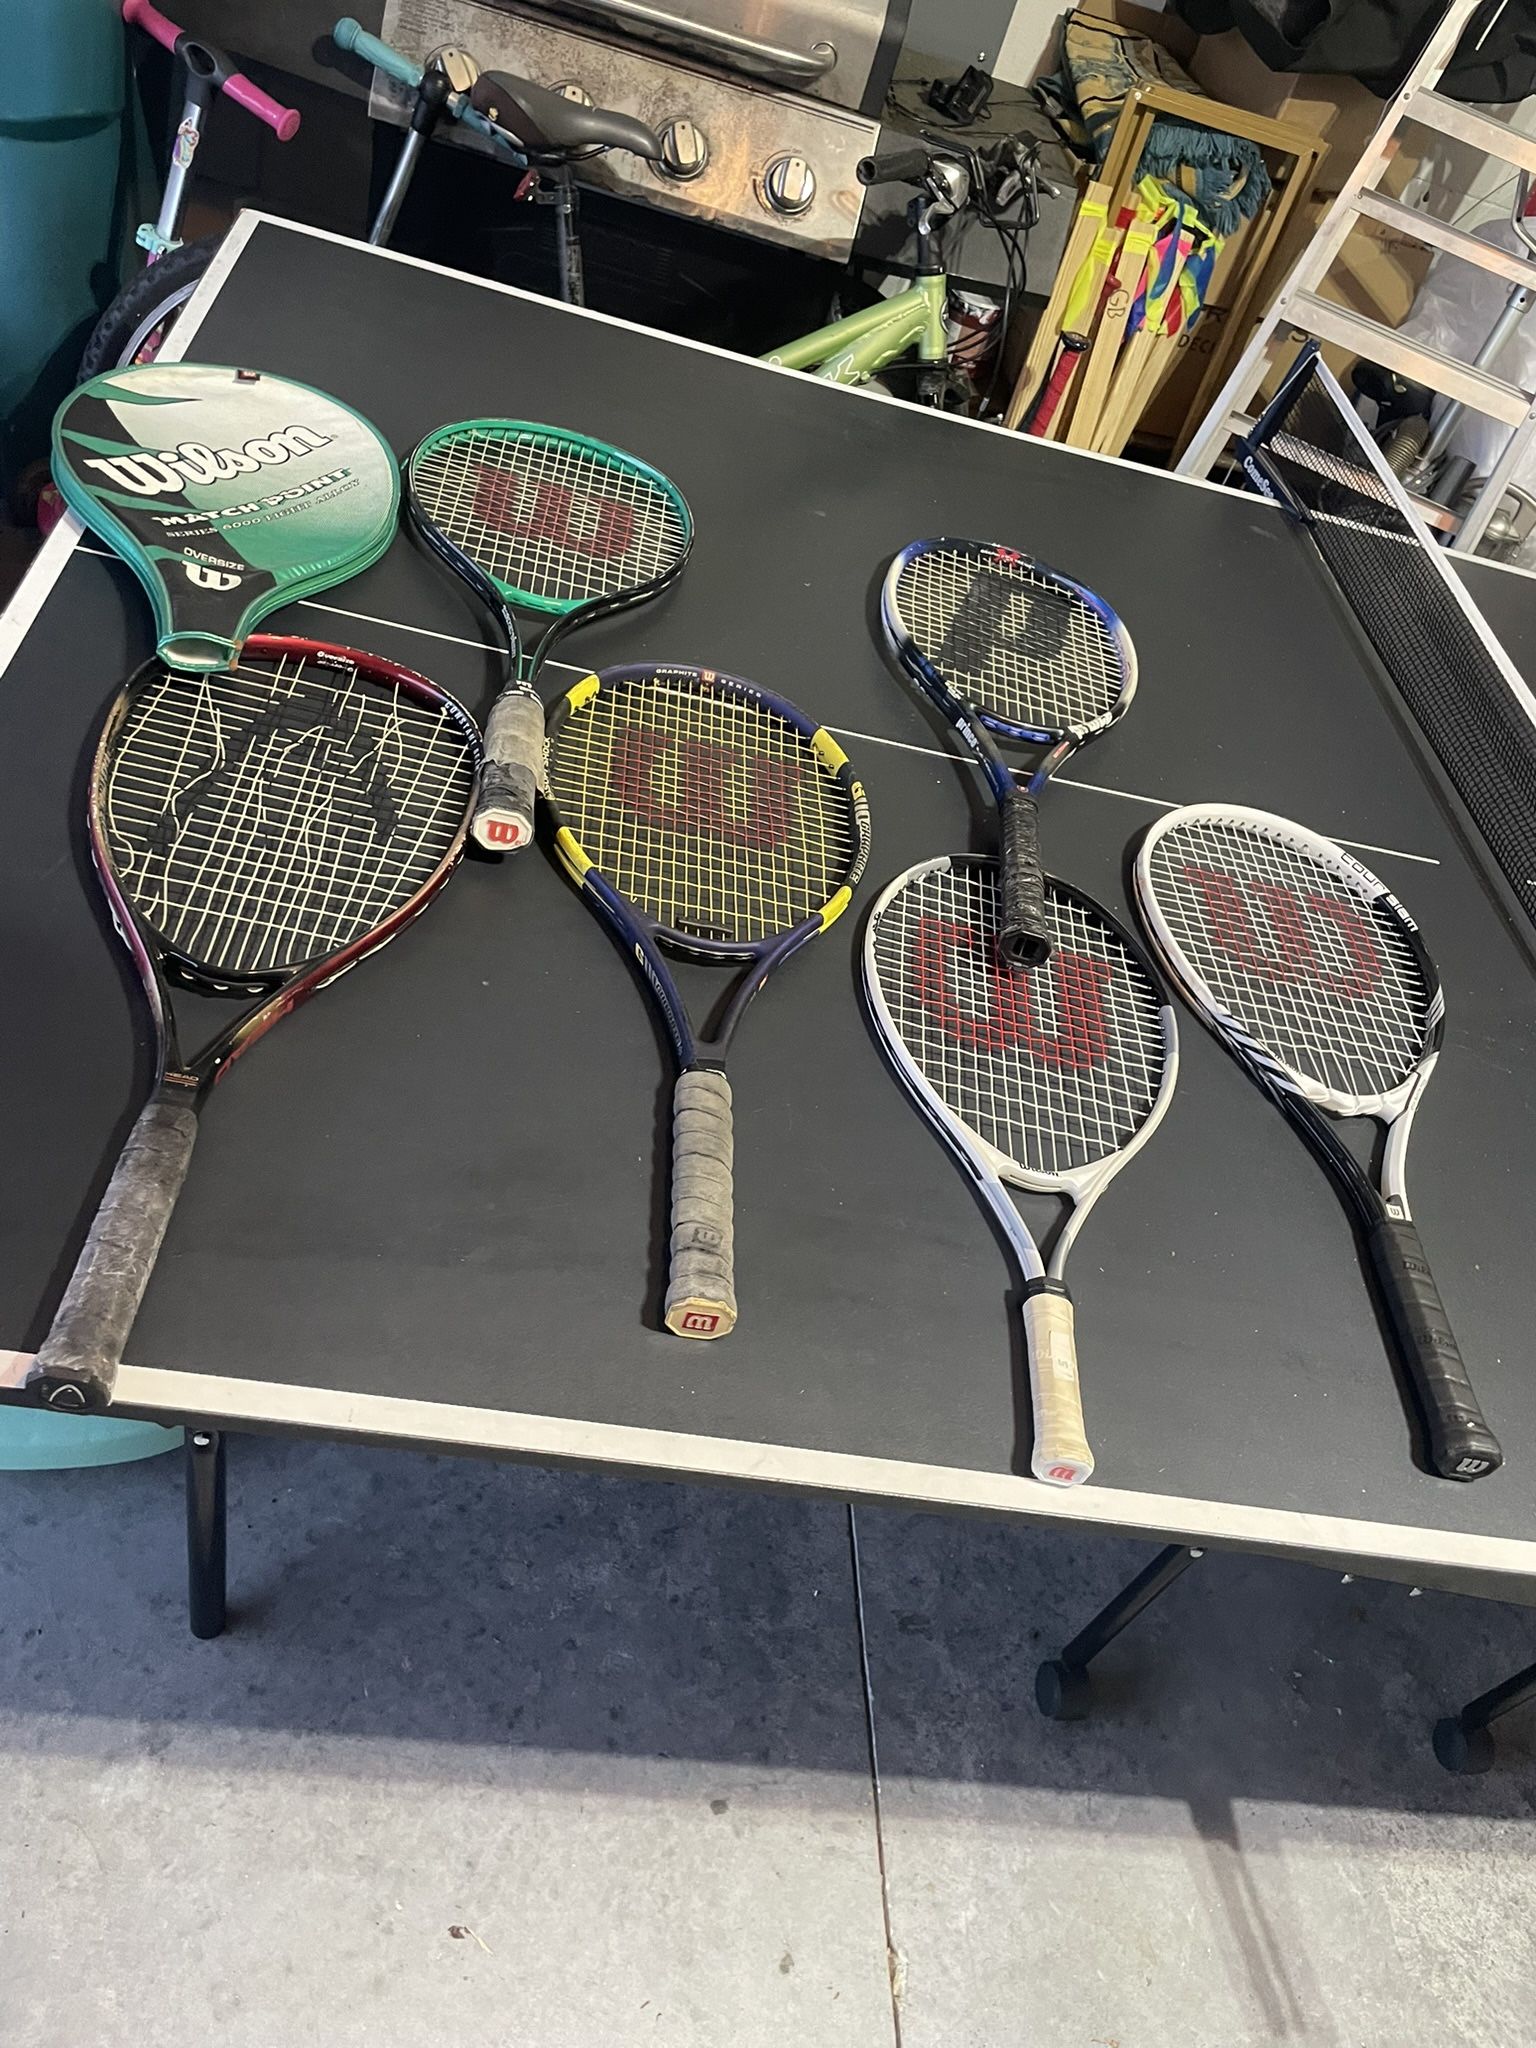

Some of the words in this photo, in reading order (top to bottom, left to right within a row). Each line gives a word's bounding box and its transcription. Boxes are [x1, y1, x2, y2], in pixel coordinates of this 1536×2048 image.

[83, 425, 333, 496] Wilson
[151, 502, 261, 526] MATCH
[258, 467, 351, 507] POINT
[166, 527, 218, 538] SERIES
[183, 546, 245, 571] OVERSIZE
[656, 668, 698, 678] GRAPHITE
[720, 678, 762, 698] SERIES
[444, 701, 478, 747] CONSTANT
[955, 716, 978, 748] prince
[1386, 893, 1419, 932] slam
